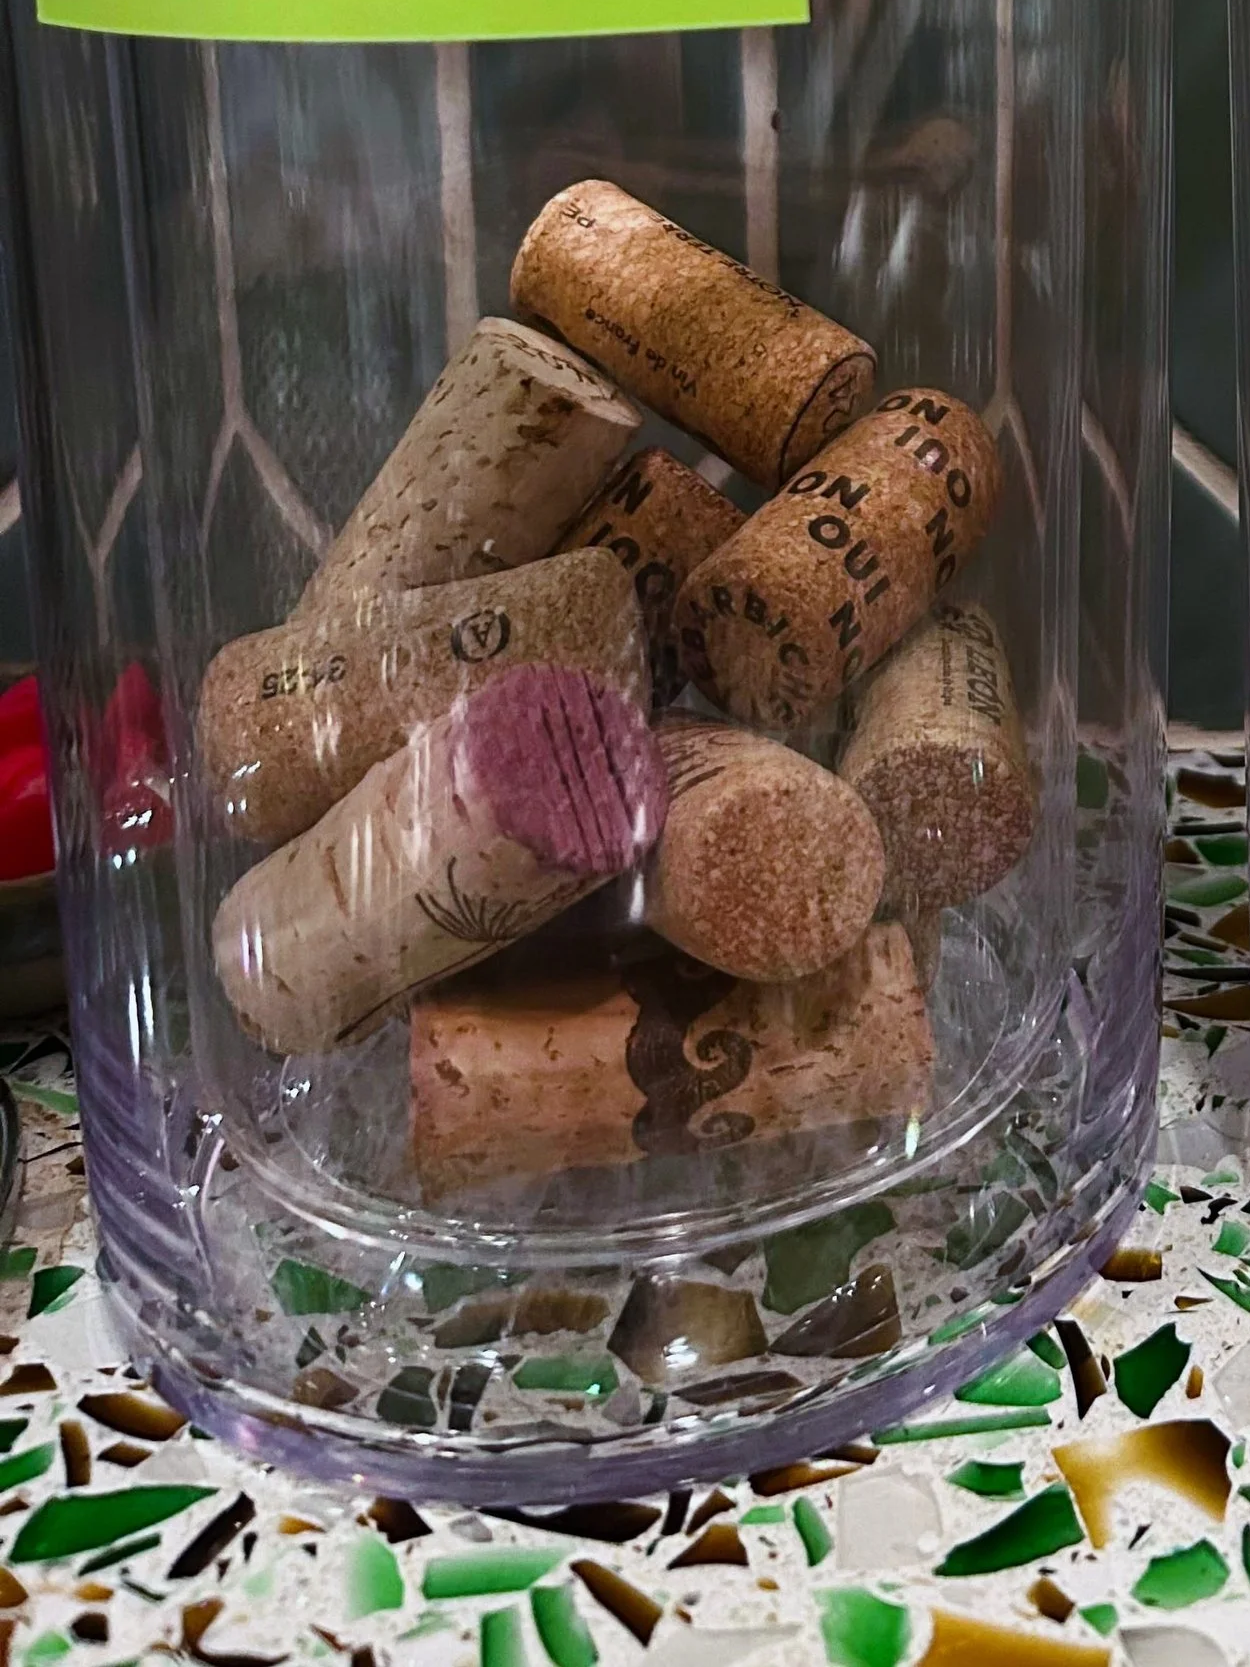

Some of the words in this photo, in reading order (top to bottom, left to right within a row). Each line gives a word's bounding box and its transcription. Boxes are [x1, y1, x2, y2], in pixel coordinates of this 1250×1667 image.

[585, 308, 641, 357] France
[645, 347, 668, 372] de
[671, 360, 698, 399] Vin
[808, 514, 891, 606] OUI
